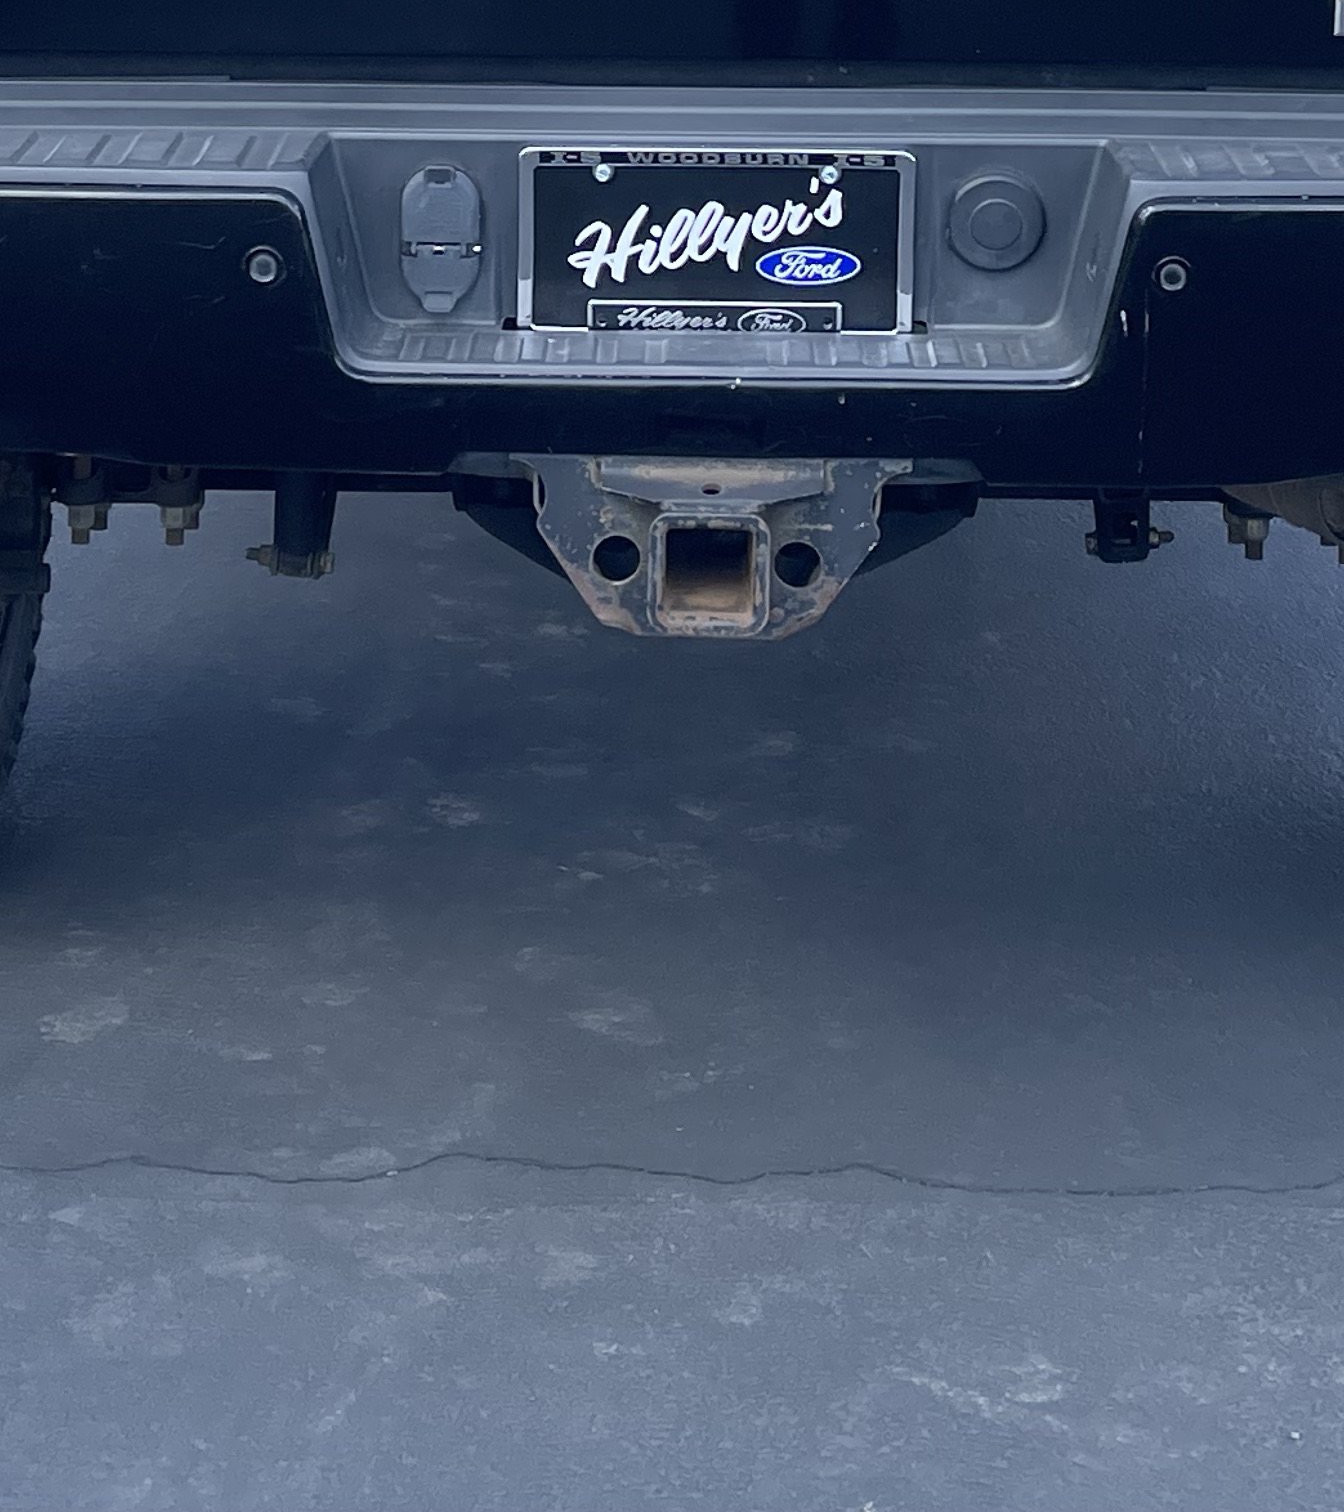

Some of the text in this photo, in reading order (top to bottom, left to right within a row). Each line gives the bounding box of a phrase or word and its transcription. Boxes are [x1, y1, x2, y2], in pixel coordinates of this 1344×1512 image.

[626, 151, 810, 166] WOODBURN
[567, 175, 844, 289] Hillyer's
[773, 250, 843, 280] Ford
[616, 306, 795, 332] Hillyer's Ford
